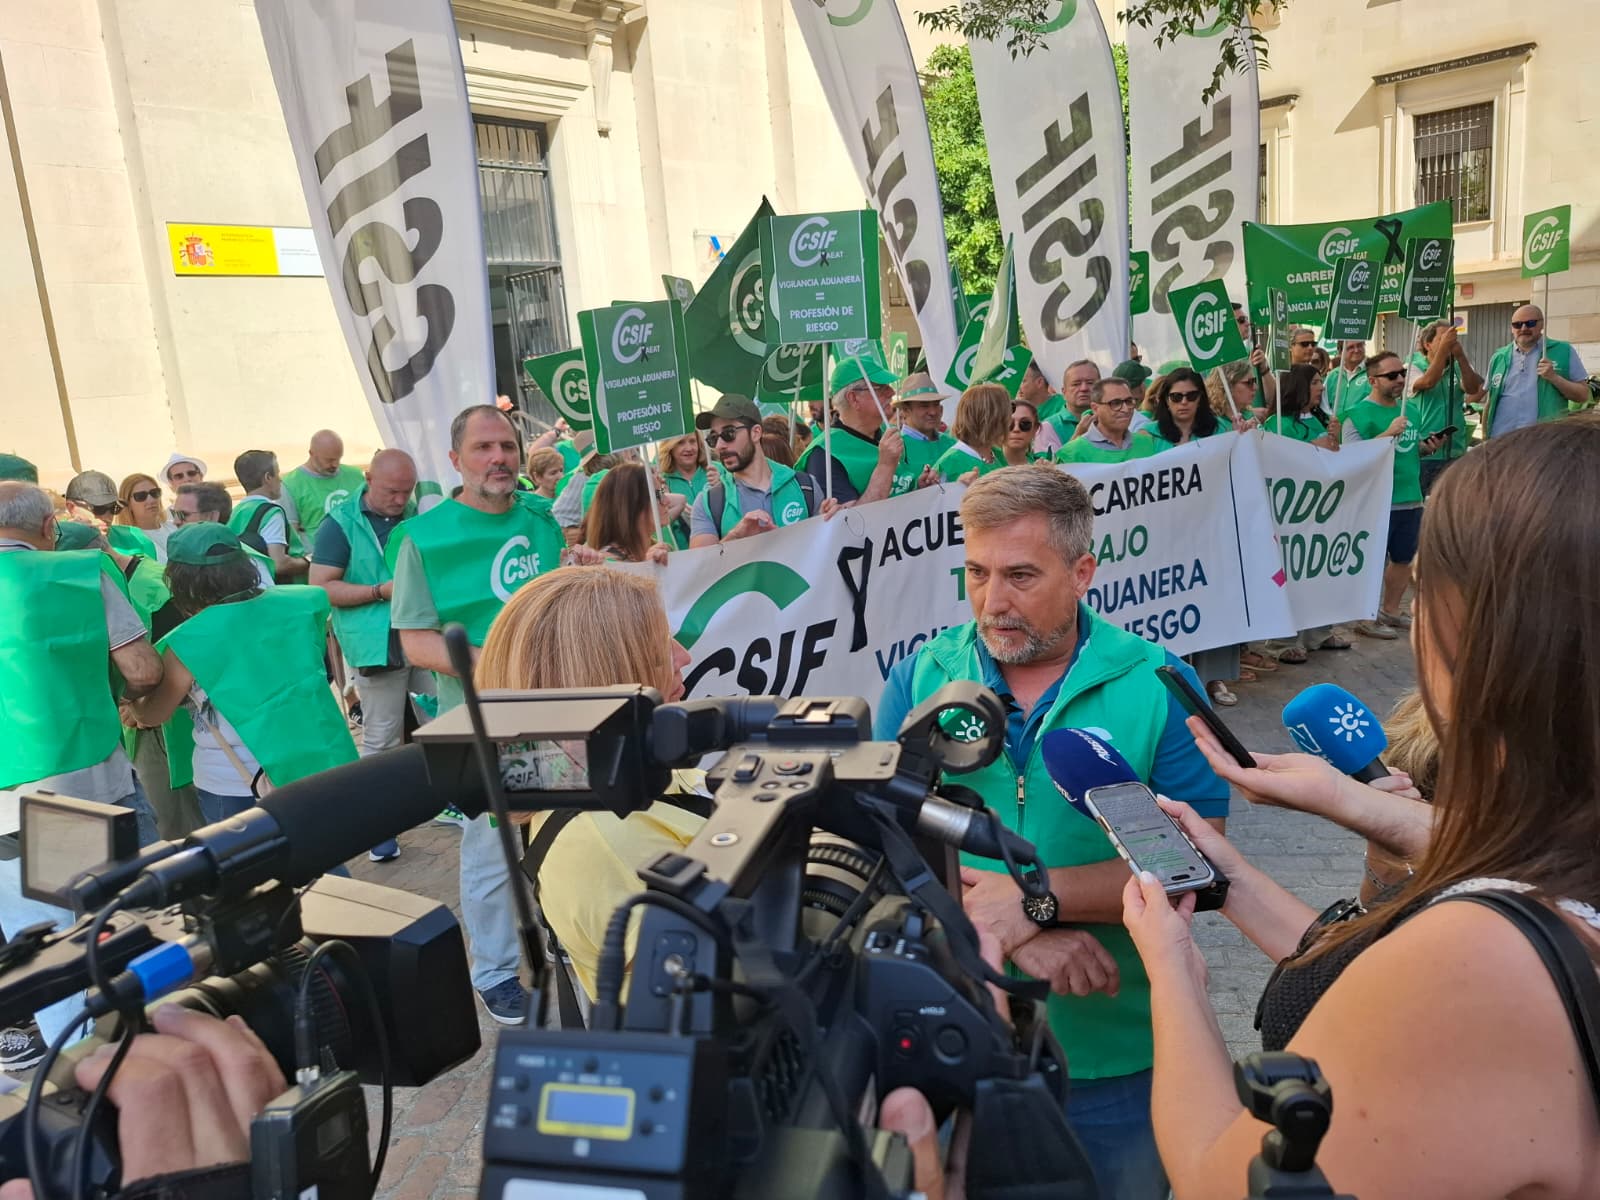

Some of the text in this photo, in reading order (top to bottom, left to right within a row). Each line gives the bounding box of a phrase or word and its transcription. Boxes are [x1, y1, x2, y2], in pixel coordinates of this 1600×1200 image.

[797, 230, 838, 251] CSIF
[1326, 237, 1360, 257] CSIF
[1531, 229, 1564, 252] CSIF
[1424, 249, 1442, 260] CSIF
[779, 274, 861, 289] VIGILANCIA ADUANERA
[1286, 270, 1334, 284] CARRER
[1352, 270, 1370, 283] CSIF
[790, 305, 854, 319] PROFESIÓN DE
[806, 321, 839, 333] RIESGO
[1194, 308, 1228, 339] CSIF
[620, 323, 654, 346] CSIF
[605, 370, 676, 390] VIGILANCIA ADUANERA
[565, 378, 590, 403] CS
[617, 402, 673, 423] PROFESIÓN DE
[632, 421, 661, 436] RIESGO
[787, 507, 804, 518] CSIF
[879, 463, 1203, 567] ACUE CARRERA
[503, 552, 540, 585] CSIF
[1087, 558, 1208, 614] DUANERA
[680, 618, 838, 700] CSIF
